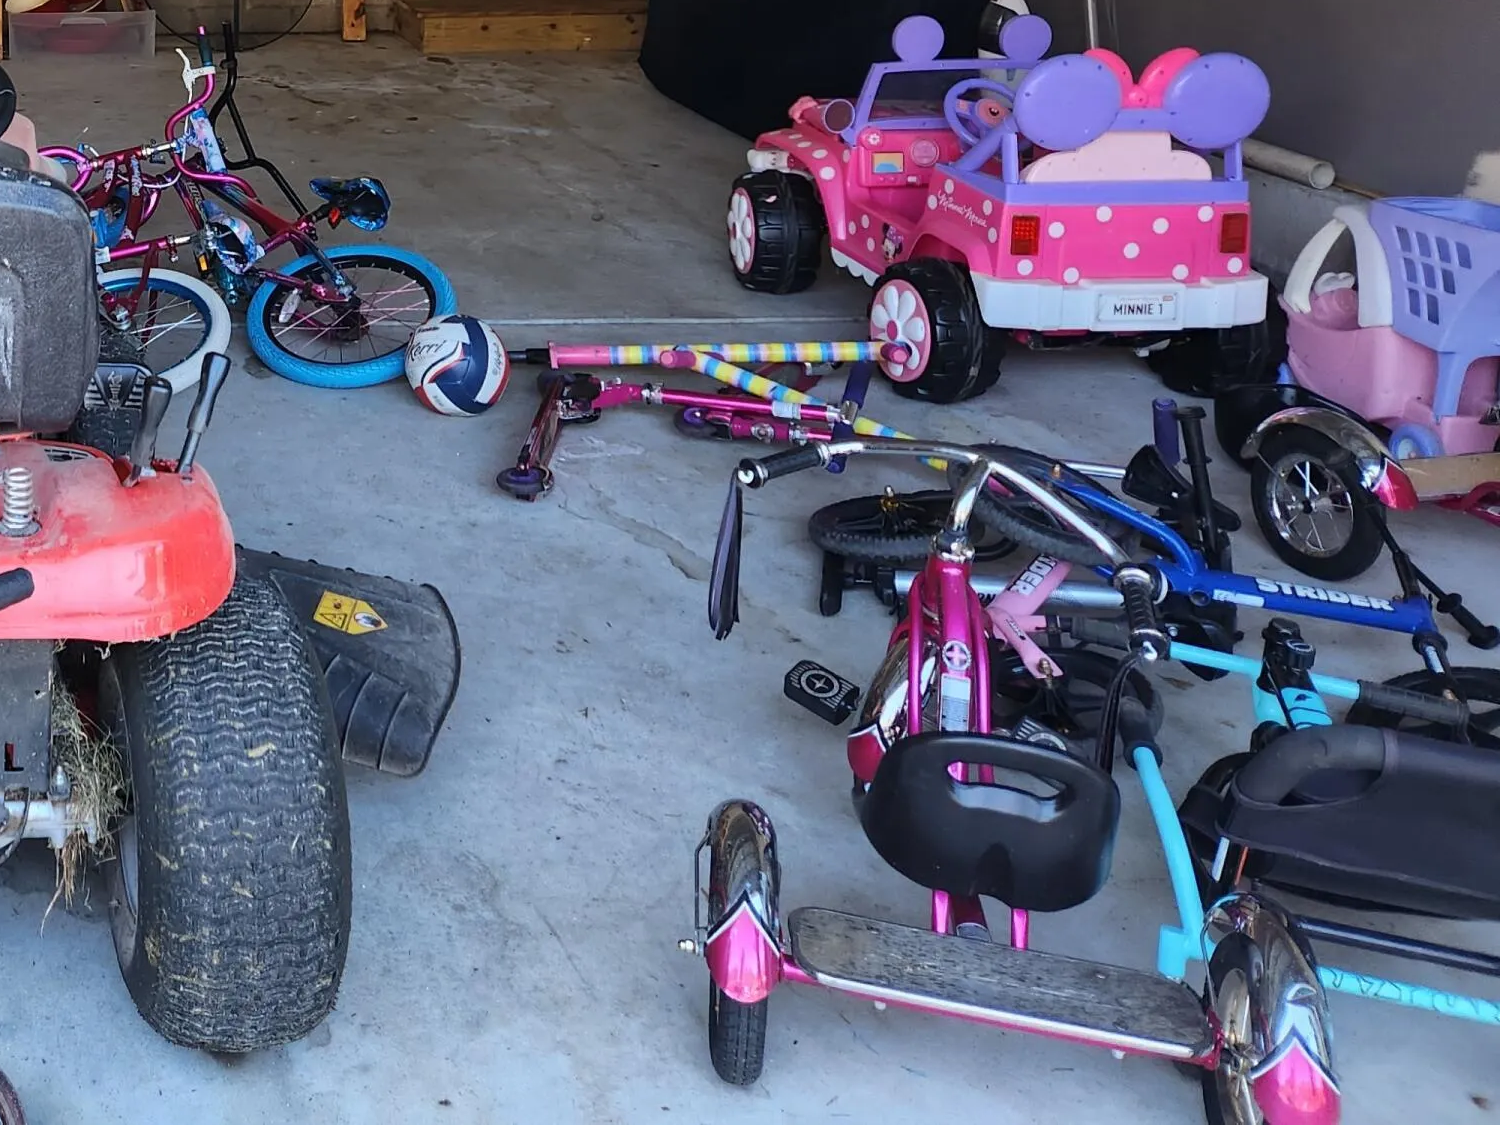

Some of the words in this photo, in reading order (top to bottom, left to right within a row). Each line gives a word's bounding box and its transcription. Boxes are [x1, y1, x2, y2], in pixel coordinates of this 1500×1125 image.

[1113, 303, 1154, 316] MINNIE
[1157, 303, 1163, 316] 1
[1254, 577, 1395, 612] STRIDER
